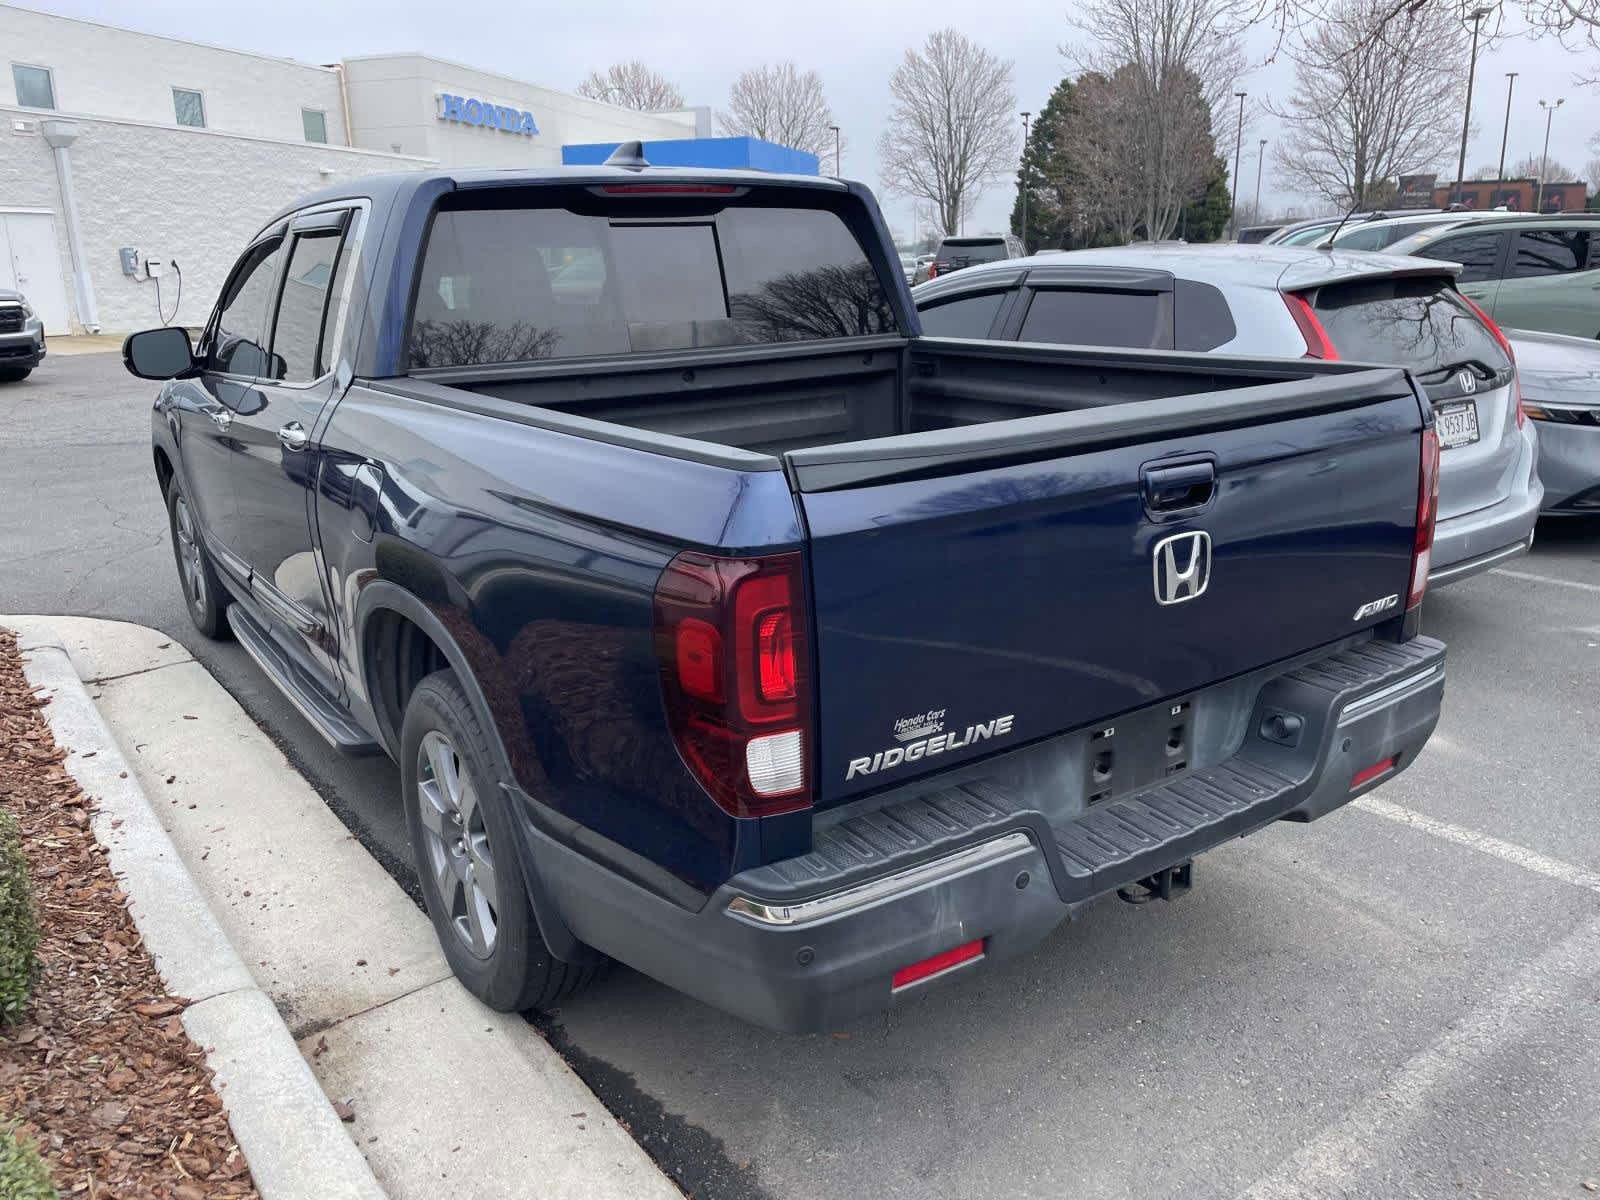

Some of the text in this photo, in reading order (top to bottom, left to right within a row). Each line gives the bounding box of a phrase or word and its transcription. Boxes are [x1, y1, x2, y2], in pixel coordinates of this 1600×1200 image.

[436, 92, 540, 136] HONDA
[894, 709, 946, 732] Honda Cars
[845, 714, 1015, 781] RIDGELINE
